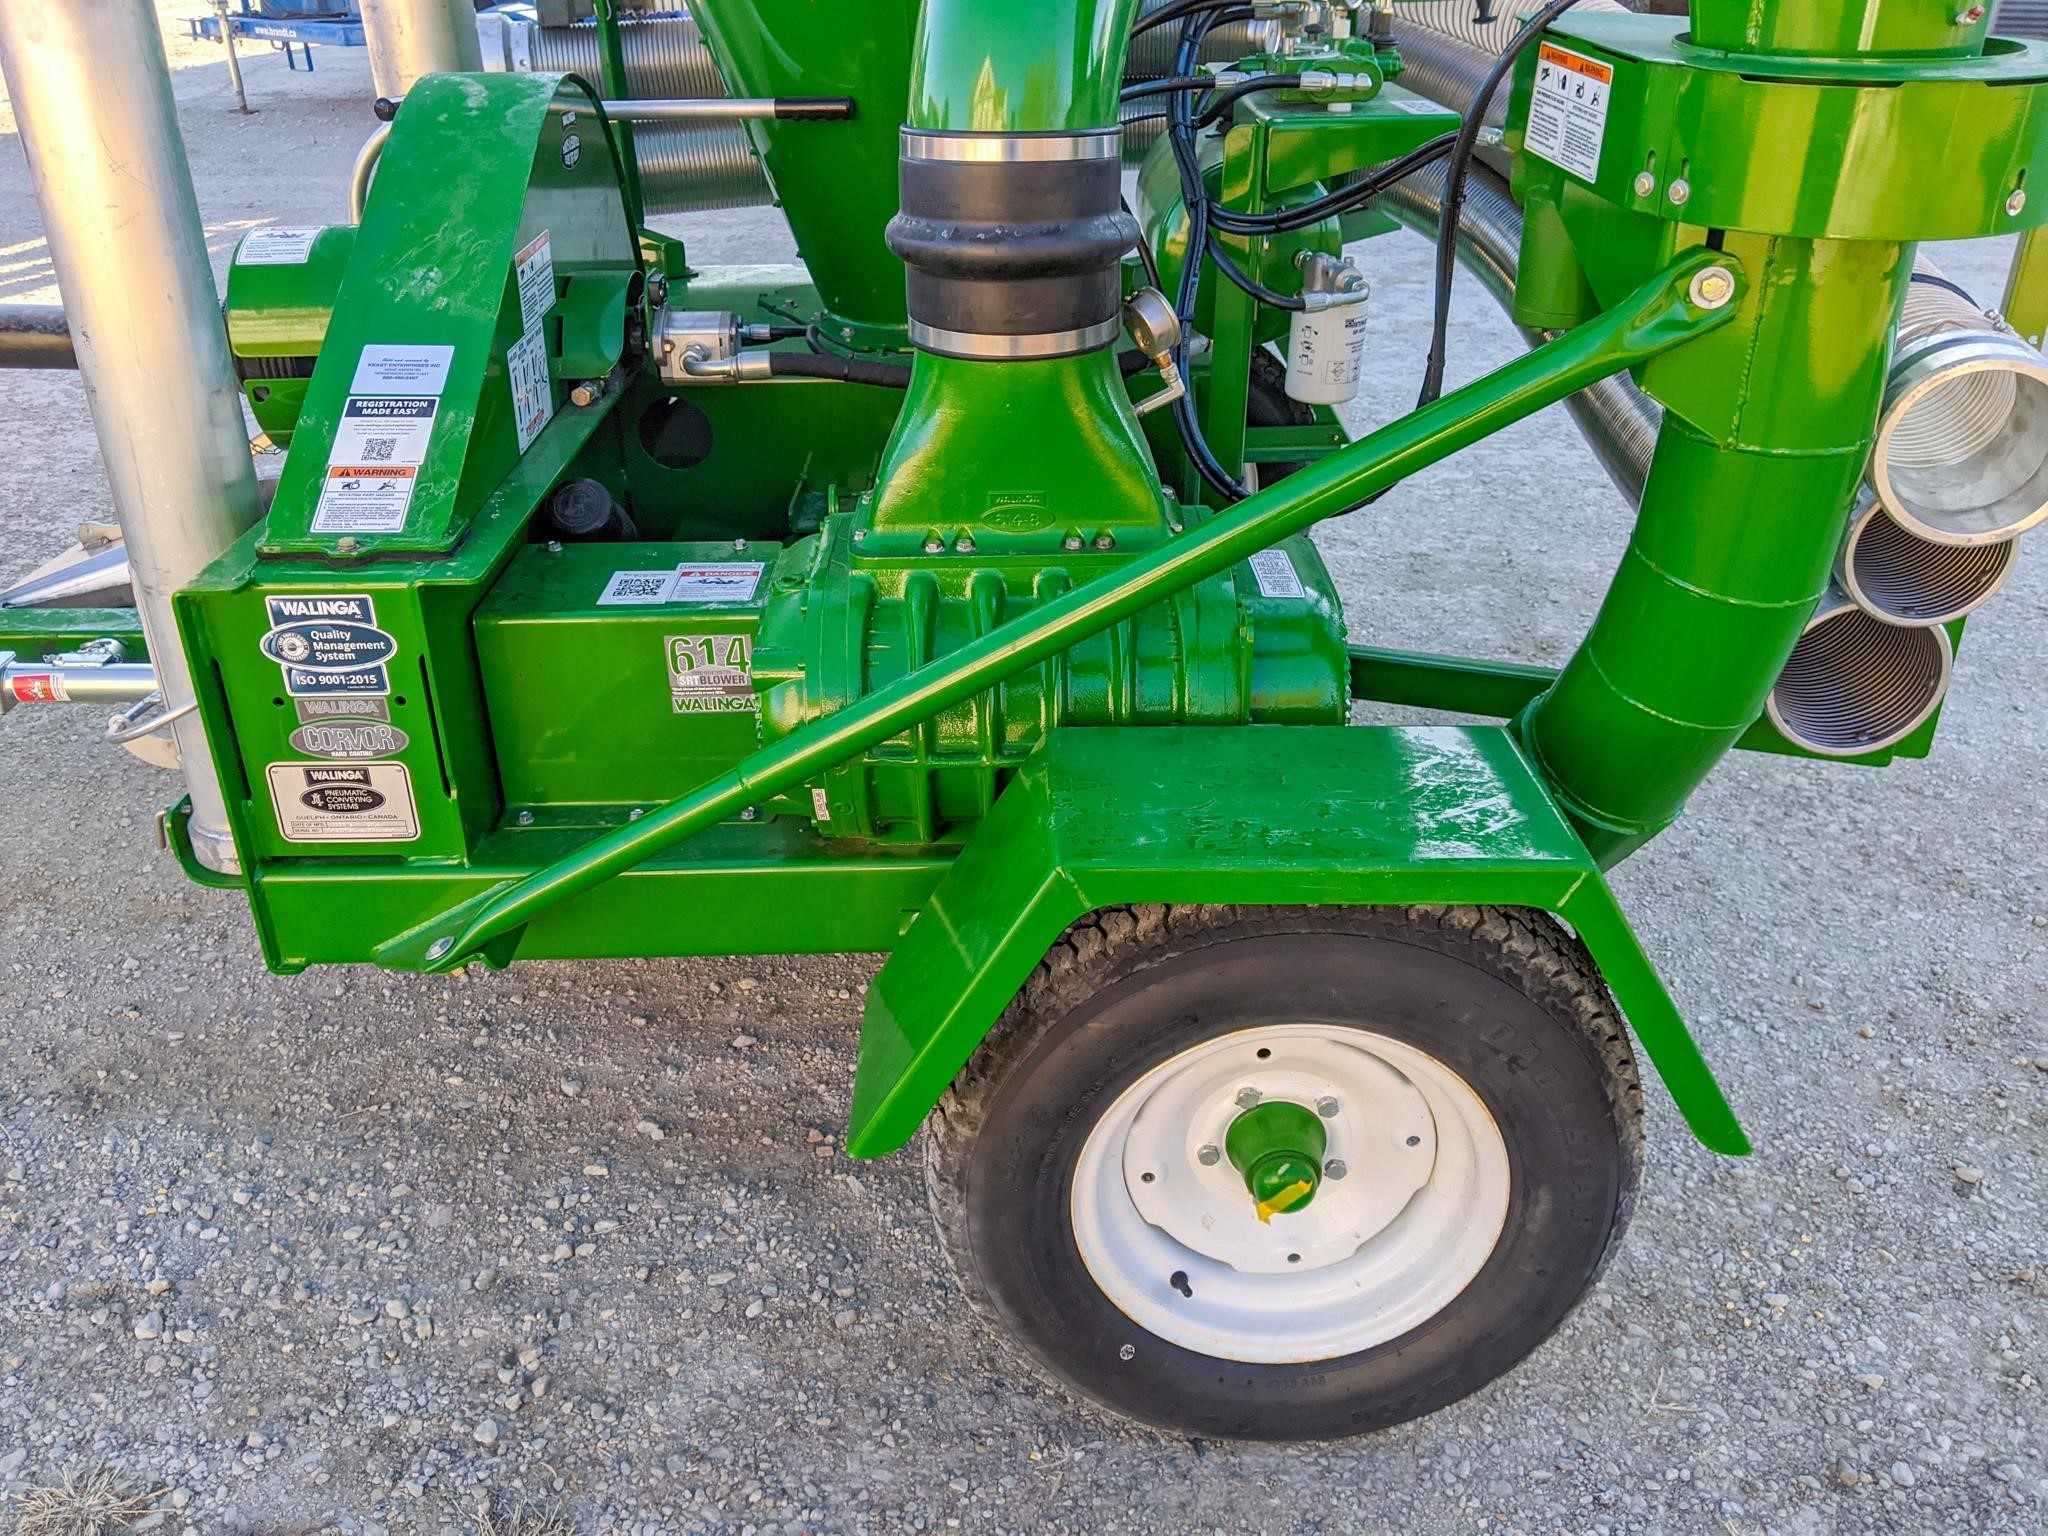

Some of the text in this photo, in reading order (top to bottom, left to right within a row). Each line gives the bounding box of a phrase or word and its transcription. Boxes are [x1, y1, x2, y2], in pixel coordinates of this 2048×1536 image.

[279, 601, 362, 616] WALINGA
[310, 631, 351, 641] Quality
[313, 641, 386, 652] Management
[316, 651, 356, 662] System
[668, 636, 750, 676] 614
[296, 674, 377, 685] ISO 9001:2015
[304, 701, 379, 714] WALINGA
[674, 697, 755, 711] WALINGA
[303, 725, 395, 751] CORVOR
[310, 770, 364, 780] WALINGA
[326, 796, 373, 804] CONVEYING
